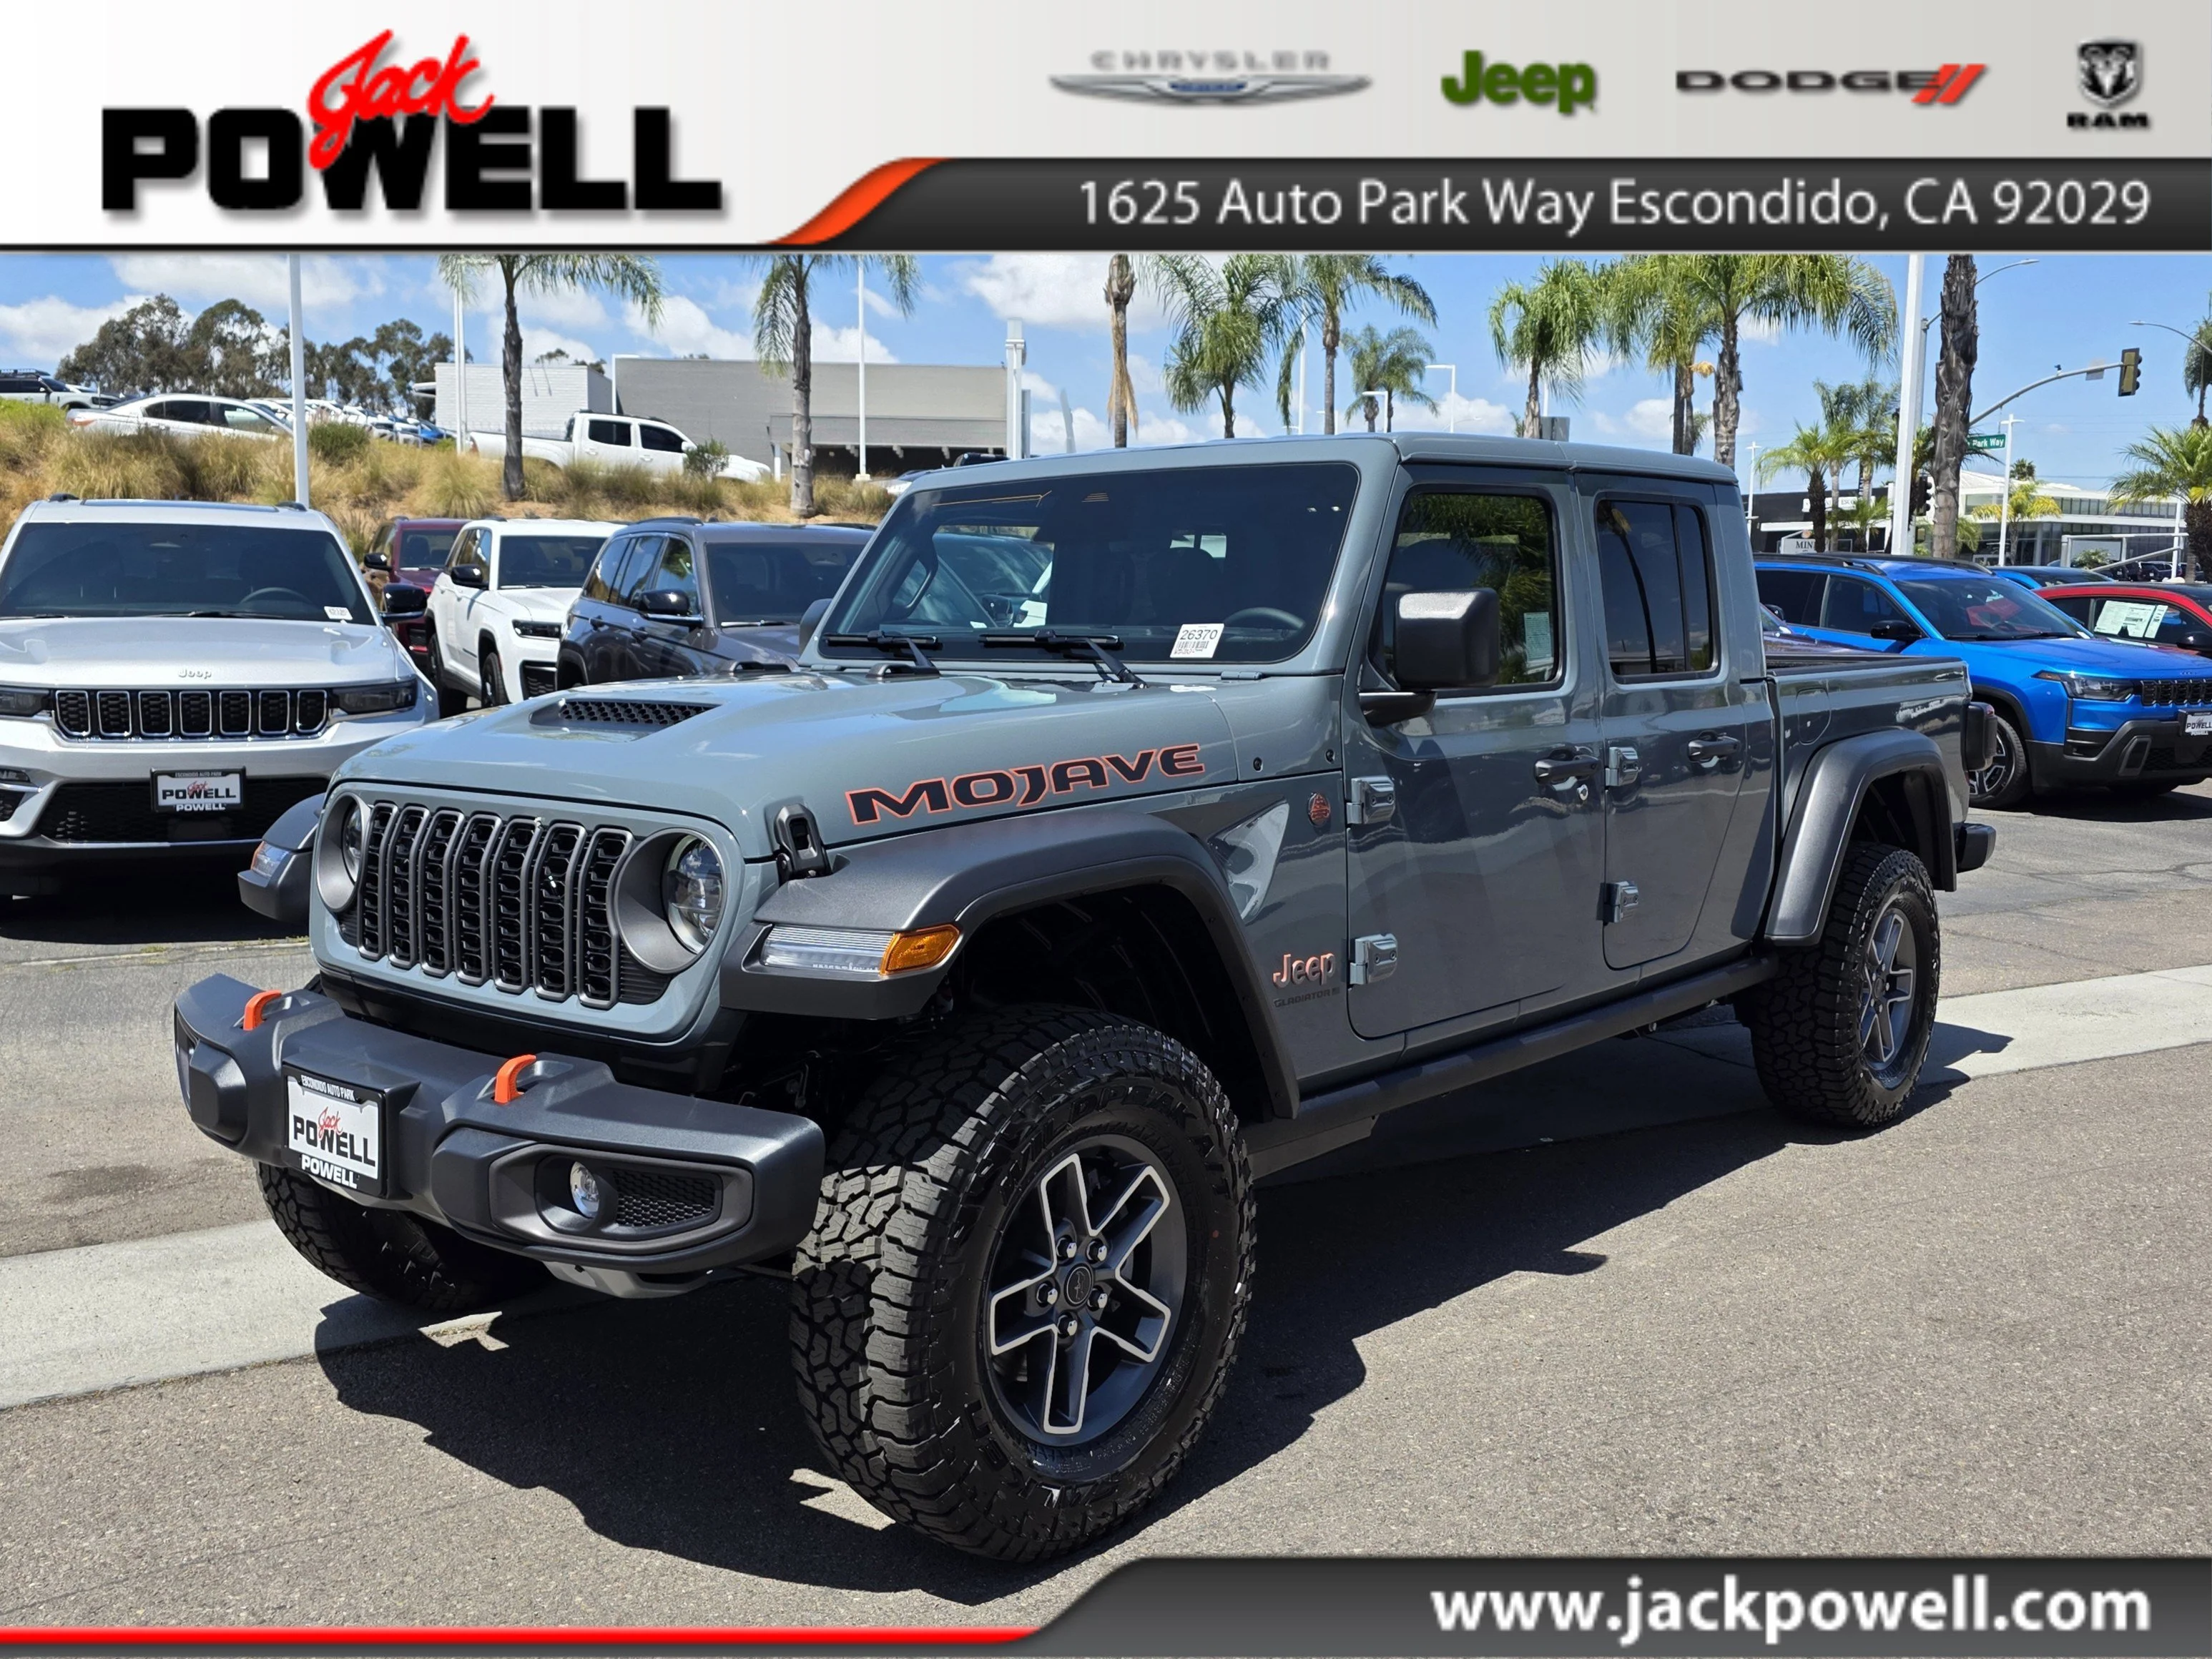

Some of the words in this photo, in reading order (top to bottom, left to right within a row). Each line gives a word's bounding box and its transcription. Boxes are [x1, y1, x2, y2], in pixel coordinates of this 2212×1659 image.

[1972, 438, 1988, 448] Park
[1990, 438, 2004, 447] Way
[1795, 541, 1814, 549] MIN
[1180, 629, 1218, 640] 26370
[178, 667, 212, 680] Jeep
[162, 787, 237, 799] POWELL
[845, 742, 1206, 825] MOJAVE
[176, 802, 226, 812] POWELL
[1272, 952, 1336, 988] Jeep
[1273, 988, 1331, 1008] GLADIATOR
[327, 1083, 340, 1098] AUTO
[340, 1086, 356, 1102] PARK
[318, 1106, 343, 1140] Jack
[293, 1114, 376, 1168] POWELL
[997, 1083, 1198, 1207] WILDPEAK
[300, 1153, 358, 1189] POWELL
